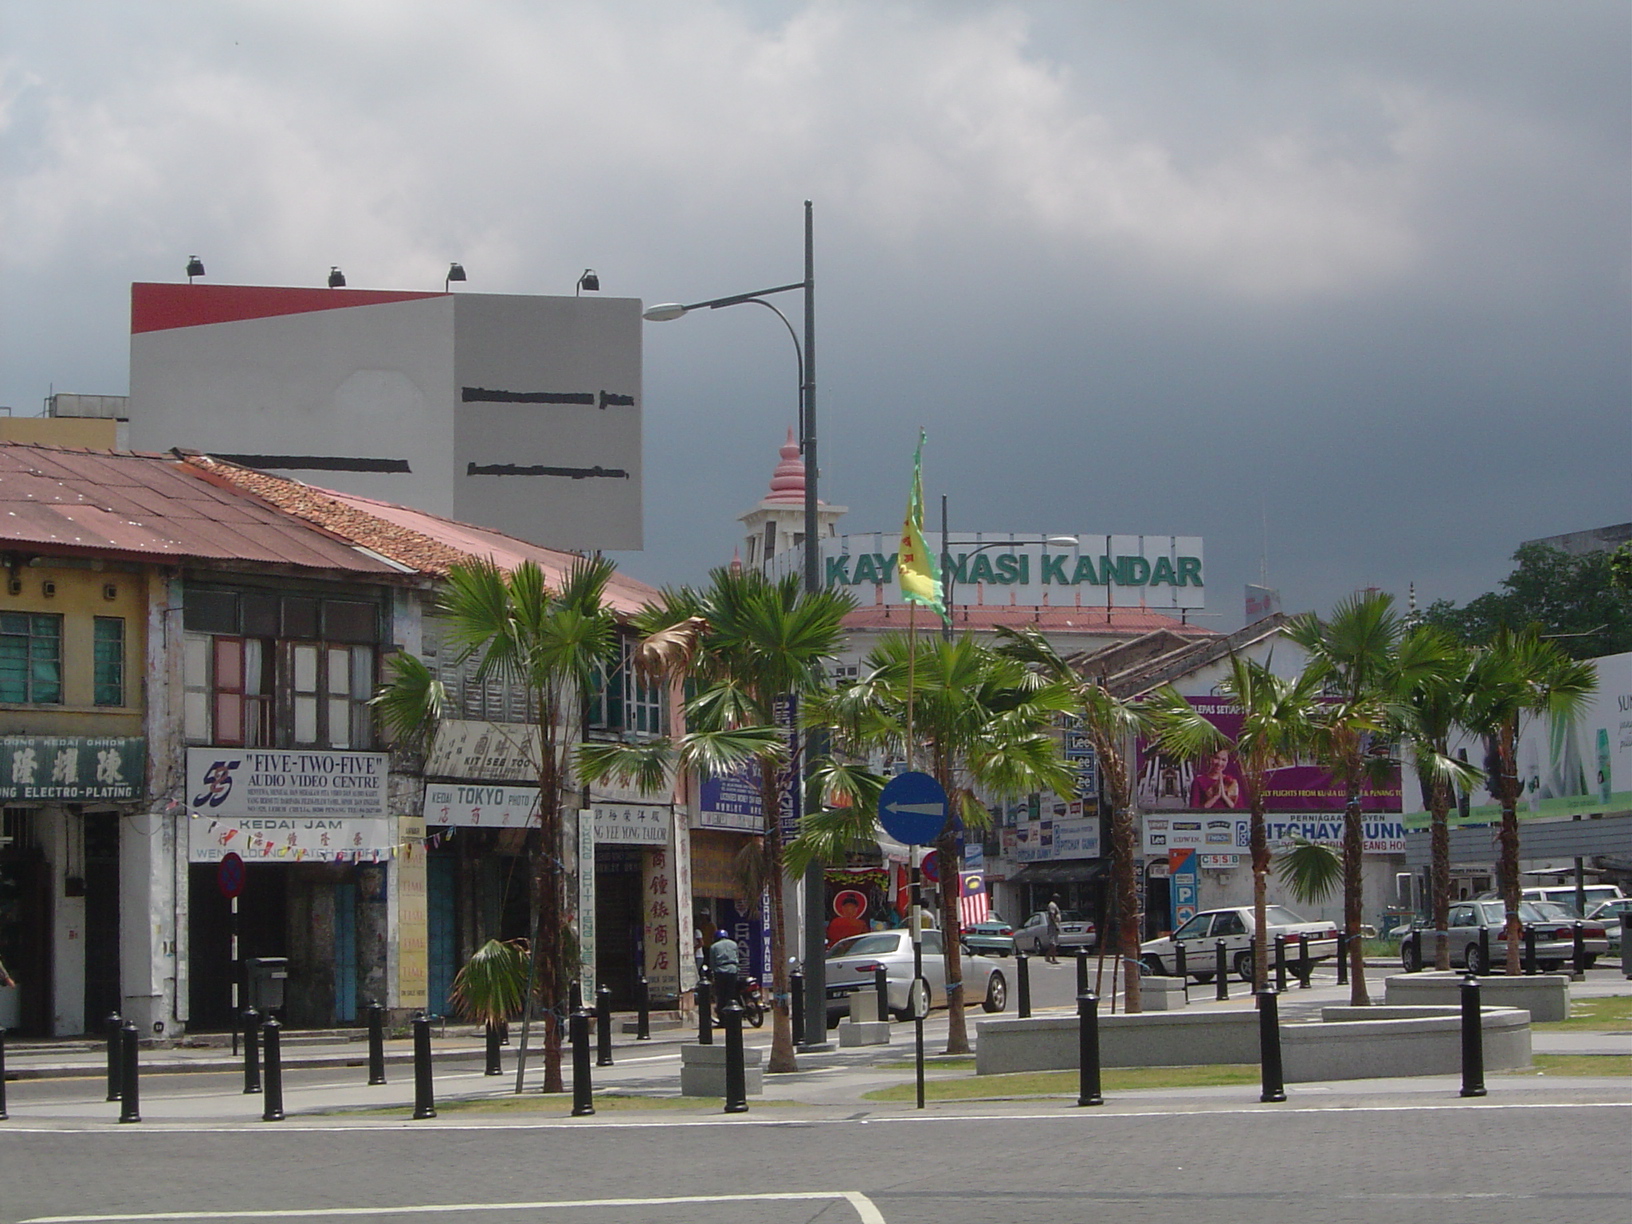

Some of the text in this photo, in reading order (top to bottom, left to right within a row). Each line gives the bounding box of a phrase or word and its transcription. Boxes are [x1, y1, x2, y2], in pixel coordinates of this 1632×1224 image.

[826, 552, 1204, 587] KAY NASI KANDAR
[1194, 704, 1215, 714] LEPAS
[43, 739, 79, 747] KEDAI
[1072, 737, 1090, 748] Lee
[246, 754, 383, 775] "FIVE-TWO-FIVE"
[464, 756, 481, 766] KIT
[511, 758, 530, 768] TOO
[248, 773, 380, 789] AUDIO VIDEO CENTRE
[0, 786, 132, 798] NG ELECTRO-PLATING
[431, 792, 453, 804] KEDAI
[457, 787, 504, 806] TOKYO
[508, 795, 530, 806] PHOTO
[1272, 789, 1297, 797] FLIGHTS
[240, 820, 343, 830] KEDAI JAM
[1266, 822, 1343, 840] ITCHAY
[582, 815, 593, 860] TUKANG
[594, 825, 667, 841] NG YEE YONG TAILOR
[1151, 834, 1166, 845] Lee
[1363, 840, 1387, 851] EANS
[402, 880, 423, 892] TIME
[582, 868, 593, 902] JAHIT
[1178, 887, 1192, 903] P
[582, 908, 593, 938] TENG
[402, 937, 424, 949] TIME
[762, 936, 772, 972] WANG
[402, 966, 424, 978] TIME
